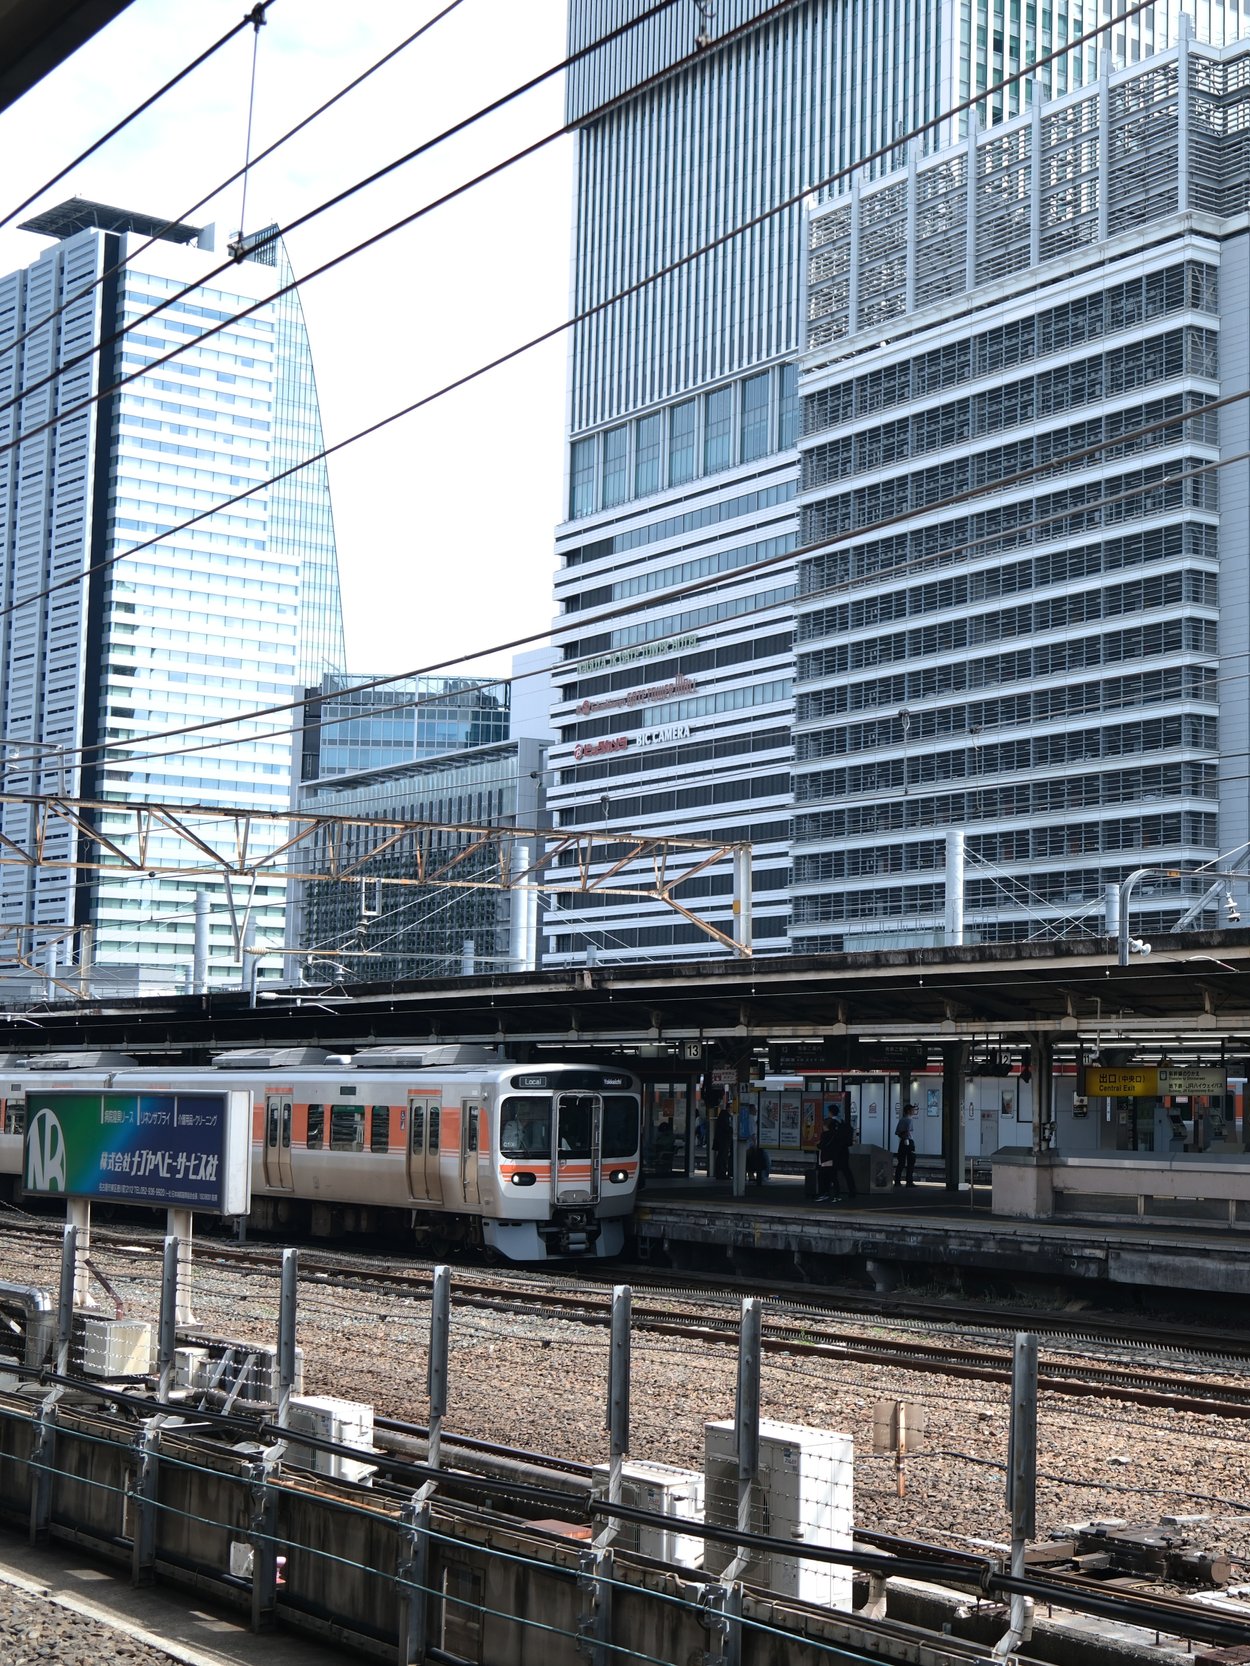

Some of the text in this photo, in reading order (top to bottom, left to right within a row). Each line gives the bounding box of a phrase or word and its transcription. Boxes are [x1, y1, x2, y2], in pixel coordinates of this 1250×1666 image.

[636, 725, 691, 747] BIC CAMERA
[687, 1045, 699, 1057] 13
[524, 1078, 542, 1086] Local
[1099, 1084, 1136, 1092] Central Exit
